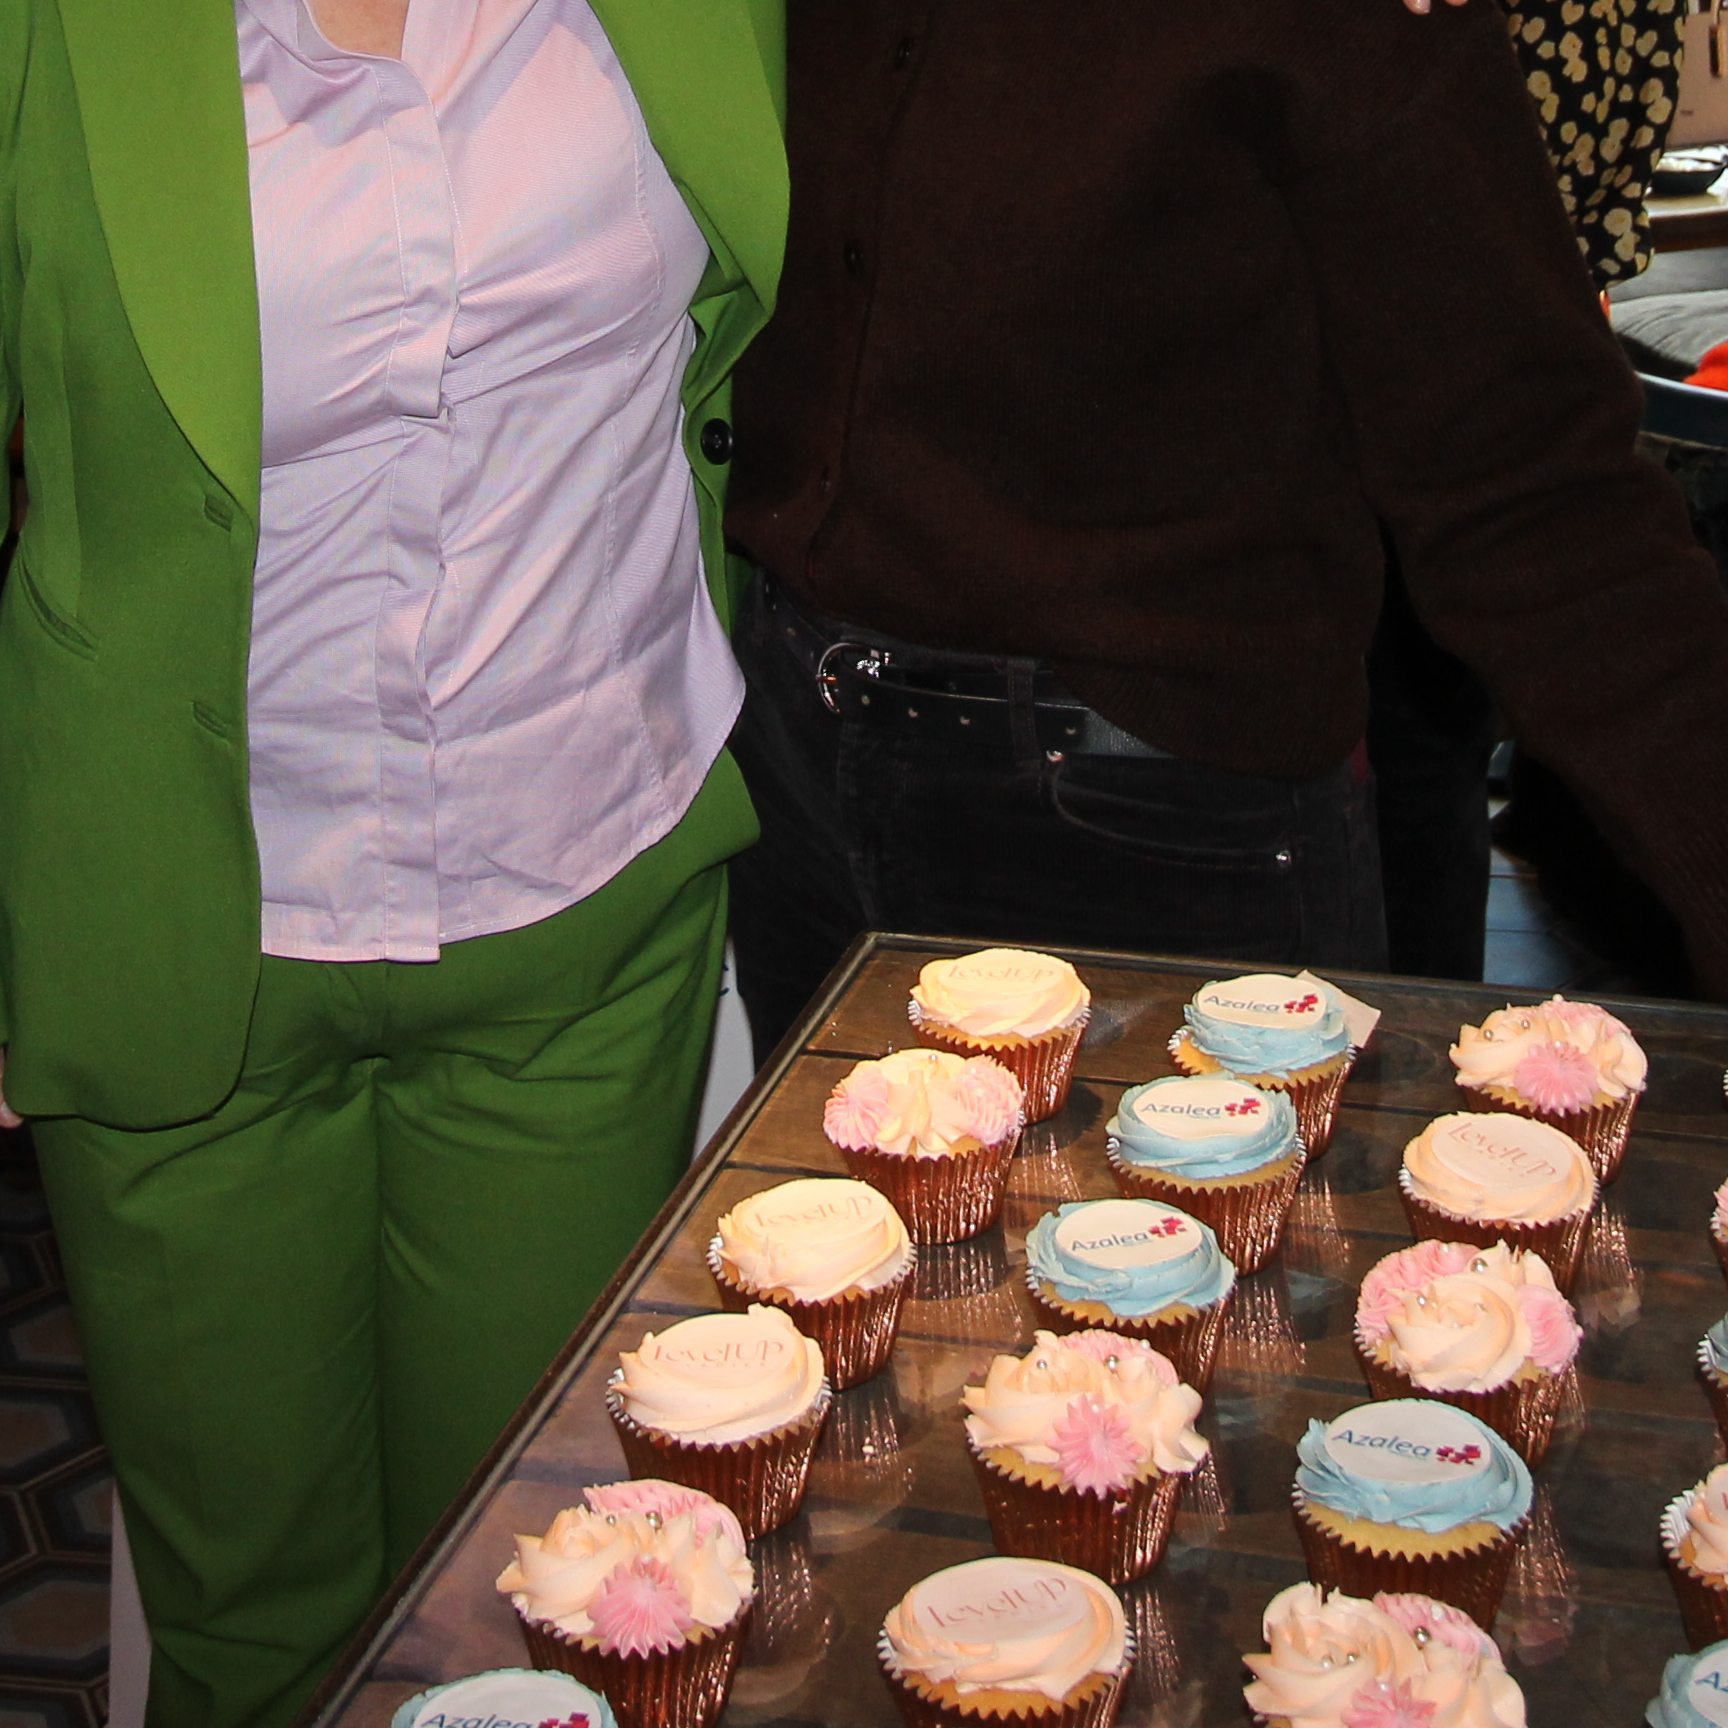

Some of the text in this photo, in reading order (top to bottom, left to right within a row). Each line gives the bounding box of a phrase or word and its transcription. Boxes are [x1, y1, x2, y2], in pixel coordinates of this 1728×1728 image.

[1202, 994, 1281, 1012] Azalea
[1140, 1102, 1222, 1117] Azalea
[1071, 1231, 1150, 1252] Azalea
[1331, 1429, 1433, 1458] Azalea
